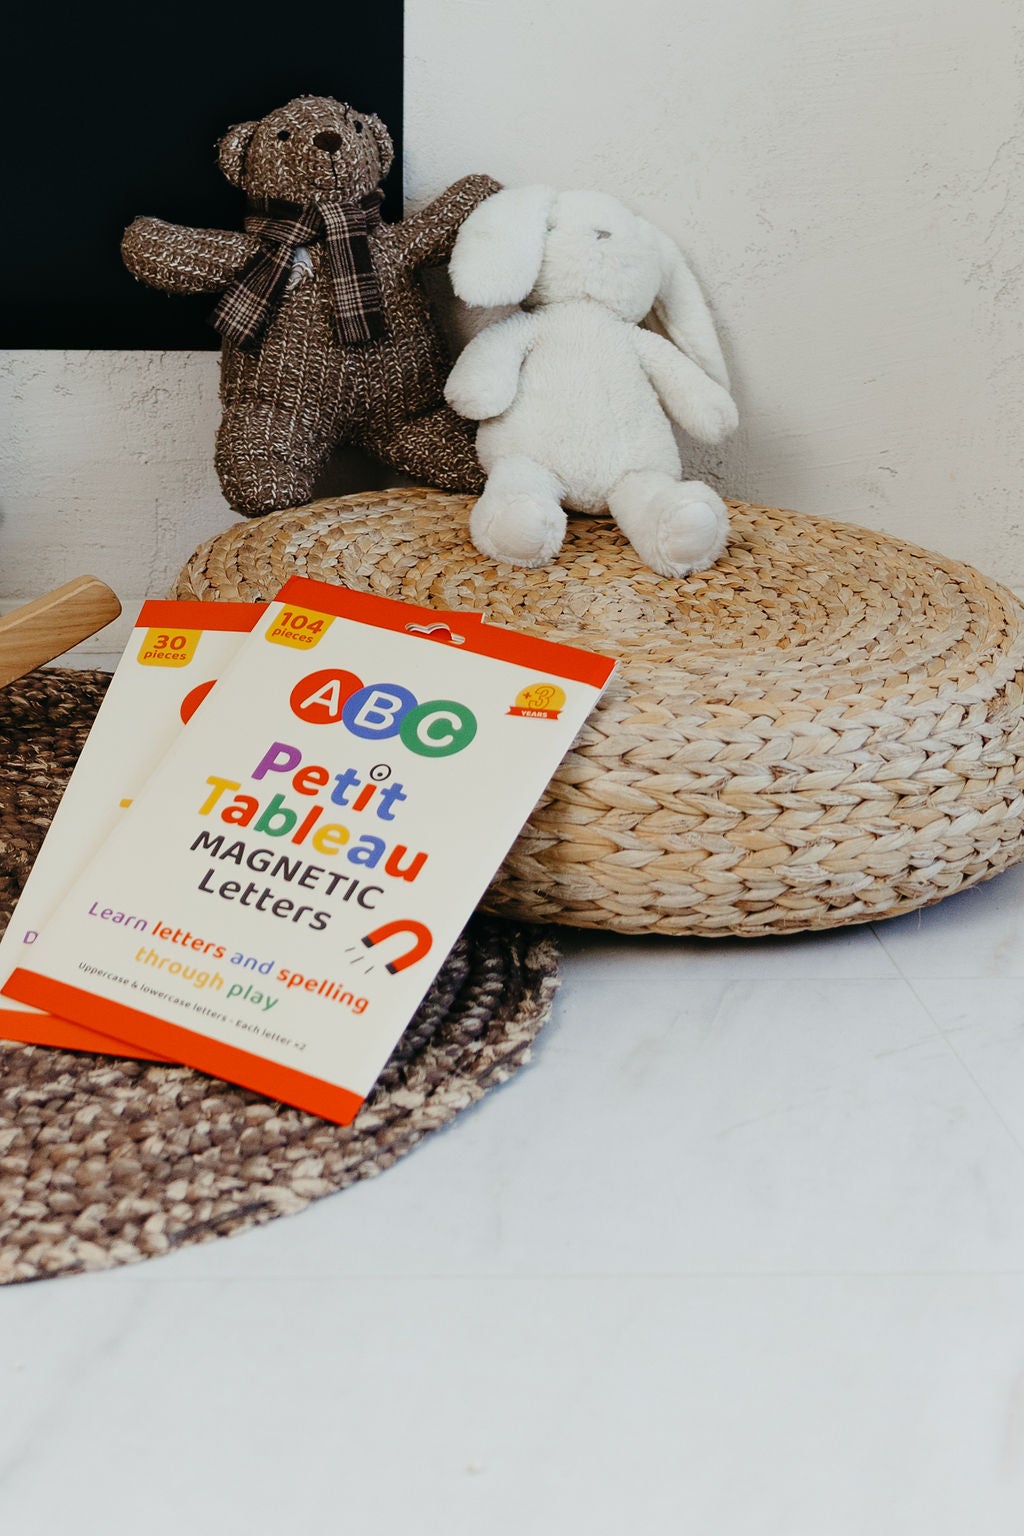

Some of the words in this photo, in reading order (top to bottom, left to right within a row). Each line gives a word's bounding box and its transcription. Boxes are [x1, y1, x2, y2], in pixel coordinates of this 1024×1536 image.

[143, 649, 187, 661] pieces
[153, 634, 187, 651] 30
[272, 627, 314, 644] pieces
[281, 611, 324, 635] 104
[299, 679, 463, 748] ABC
[521, 710, 548, 718] YEARS
[251, 741, 407, 821] Petit
[198, 775, 429, 883] Tableau
[189, 830, 385, 910] MAGNETIC
[198, 868, 332, 931] Letters
[88, 901, 148, 932] Learn
[151, 921, 227, 959] letters
[230, 952, 275, 975] and
[277, 968, 369, 1015] spelling
[134, 946, 225, 991] through
[226, 983, 279, 1012] play
[78, 962, 129, 985] Uppercase
[139, 983, 191, 1008] lowercase
[193, 1003, 227, 1022] letters
[235, 1020, 260, 1035] Each
[261, 1029, 291, 1045] letter
